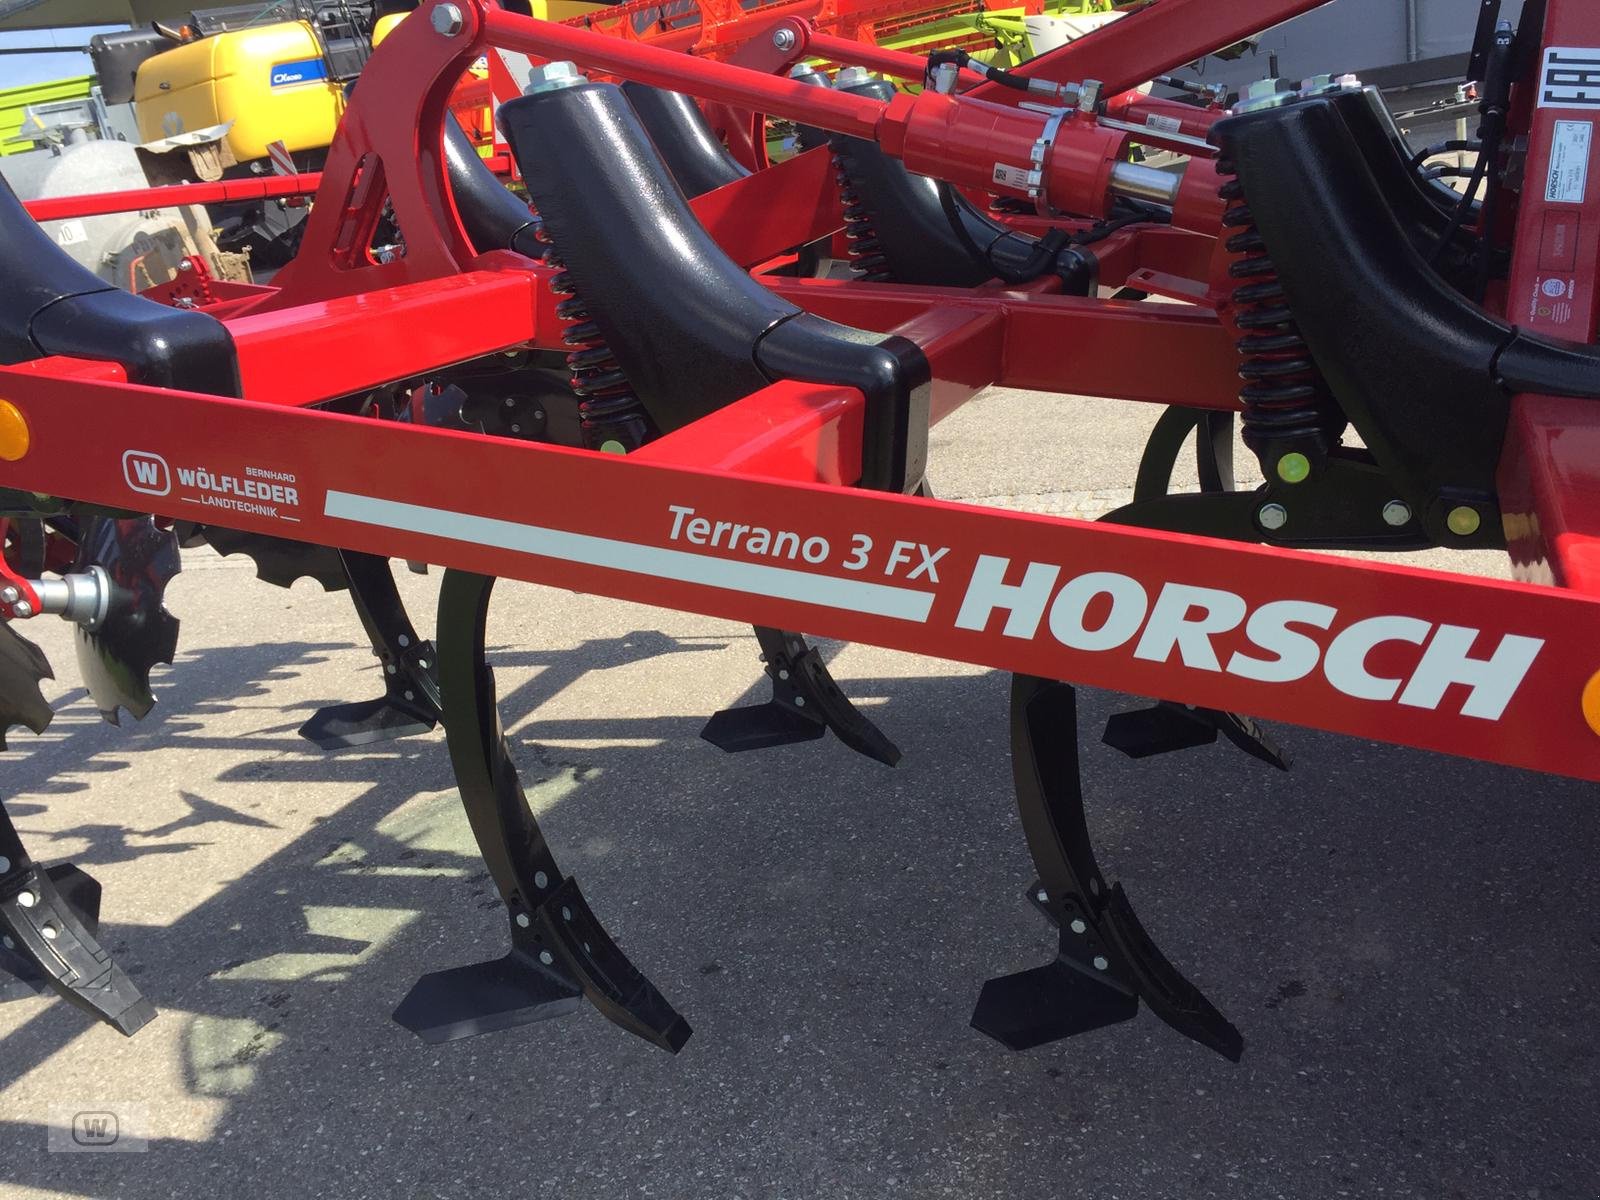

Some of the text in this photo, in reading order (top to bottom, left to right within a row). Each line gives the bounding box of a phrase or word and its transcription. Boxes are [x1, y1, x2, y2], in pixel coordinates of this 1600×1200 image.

[1549, 169, 1559, 199] HORSCH
[177, 467, 299, 506] WÖLFLEDER
[246, 467, 296, 483] BERNHARD
[201, 494, 278, 518] LANDTECHNIK
[668, 505, 950, 583] Terrano 3 FX
[954, 554, 1545, 721] HORSCH
